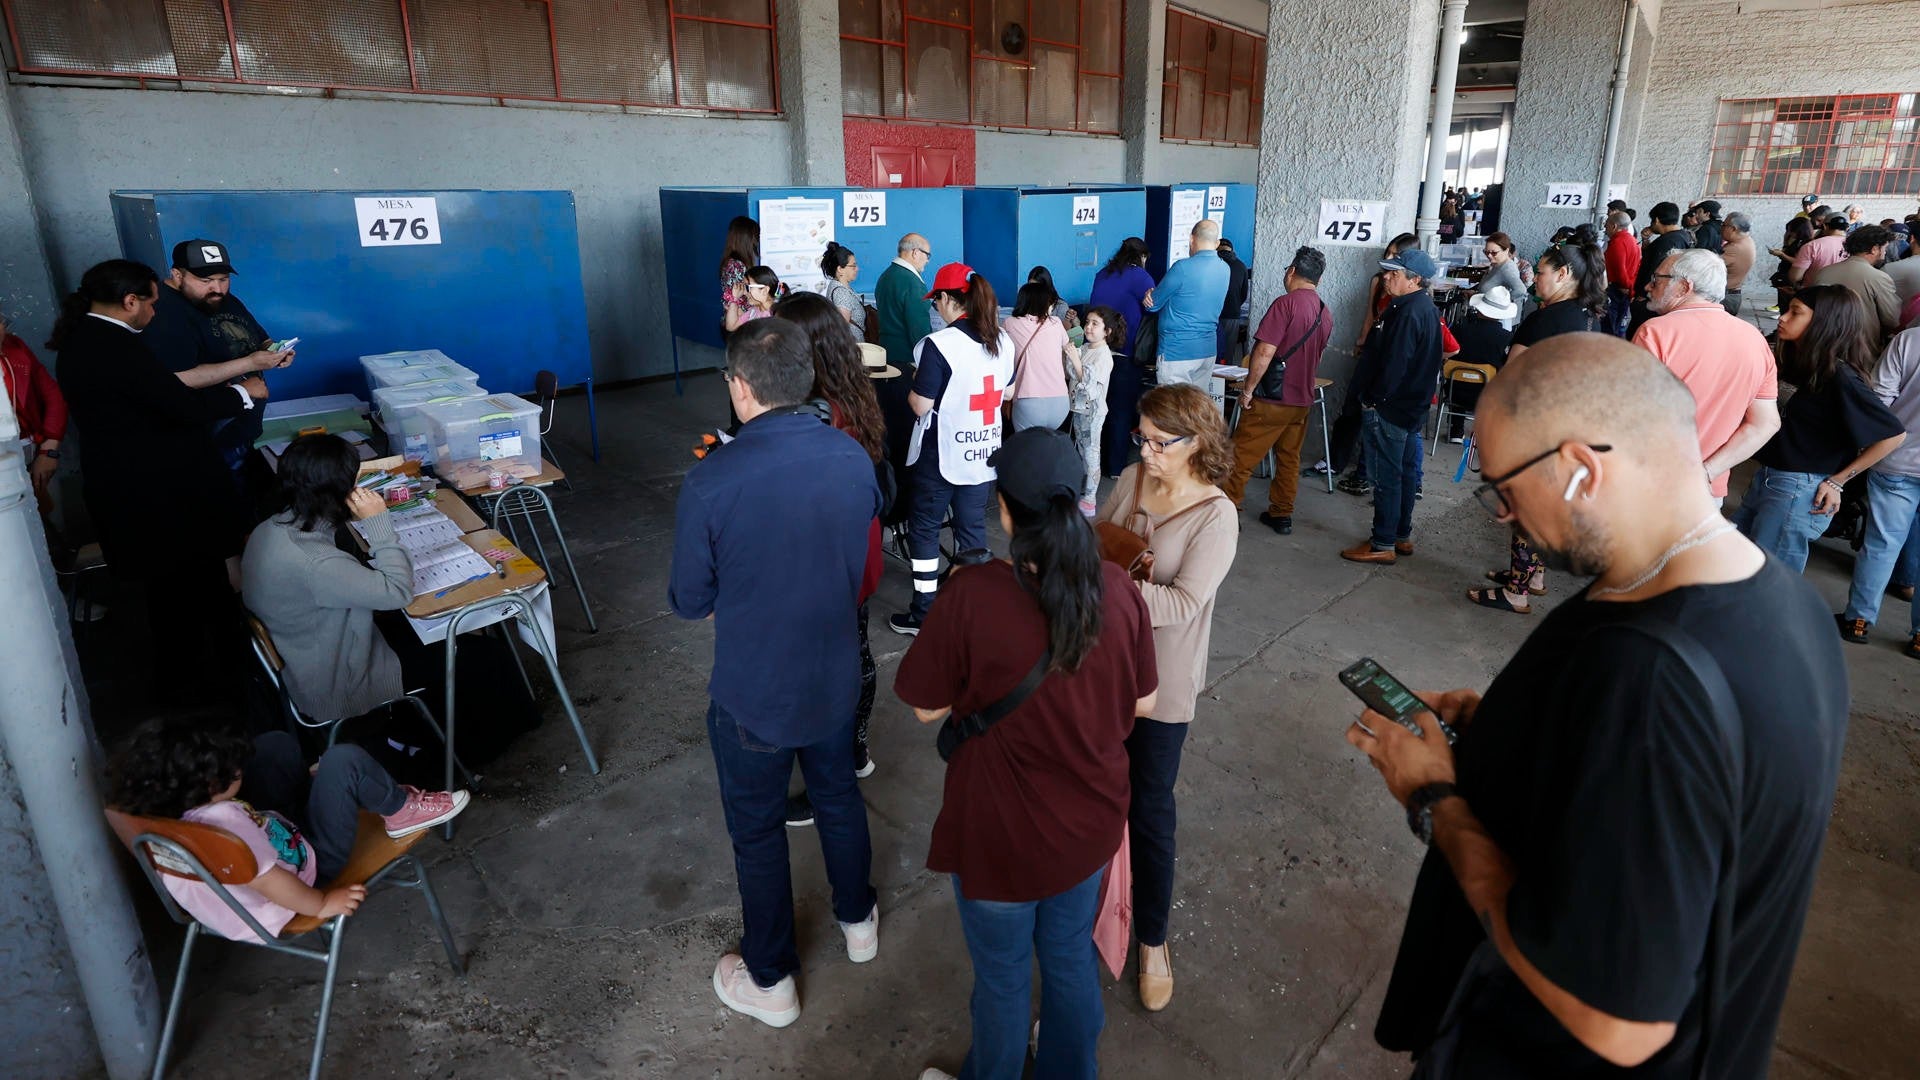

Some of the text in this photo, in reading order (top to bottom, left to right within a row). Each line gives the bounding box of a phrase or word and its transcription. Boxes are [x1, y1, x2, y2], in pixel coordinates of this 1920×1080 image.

[377, 199, 414, 209] MESA
[1209, 196, 1224, 207] 473
[1551, 194, 1582, 206] 473
[849, 206, 880, 223] 475
[1075, 208, 1095, 221] 474
[1337, 204, 1365, 214] MESA
[369, 217, 429, 241] 476
[1324, 220, 1372, 242] 475
[954, 429, 989, 444] CRUZ
